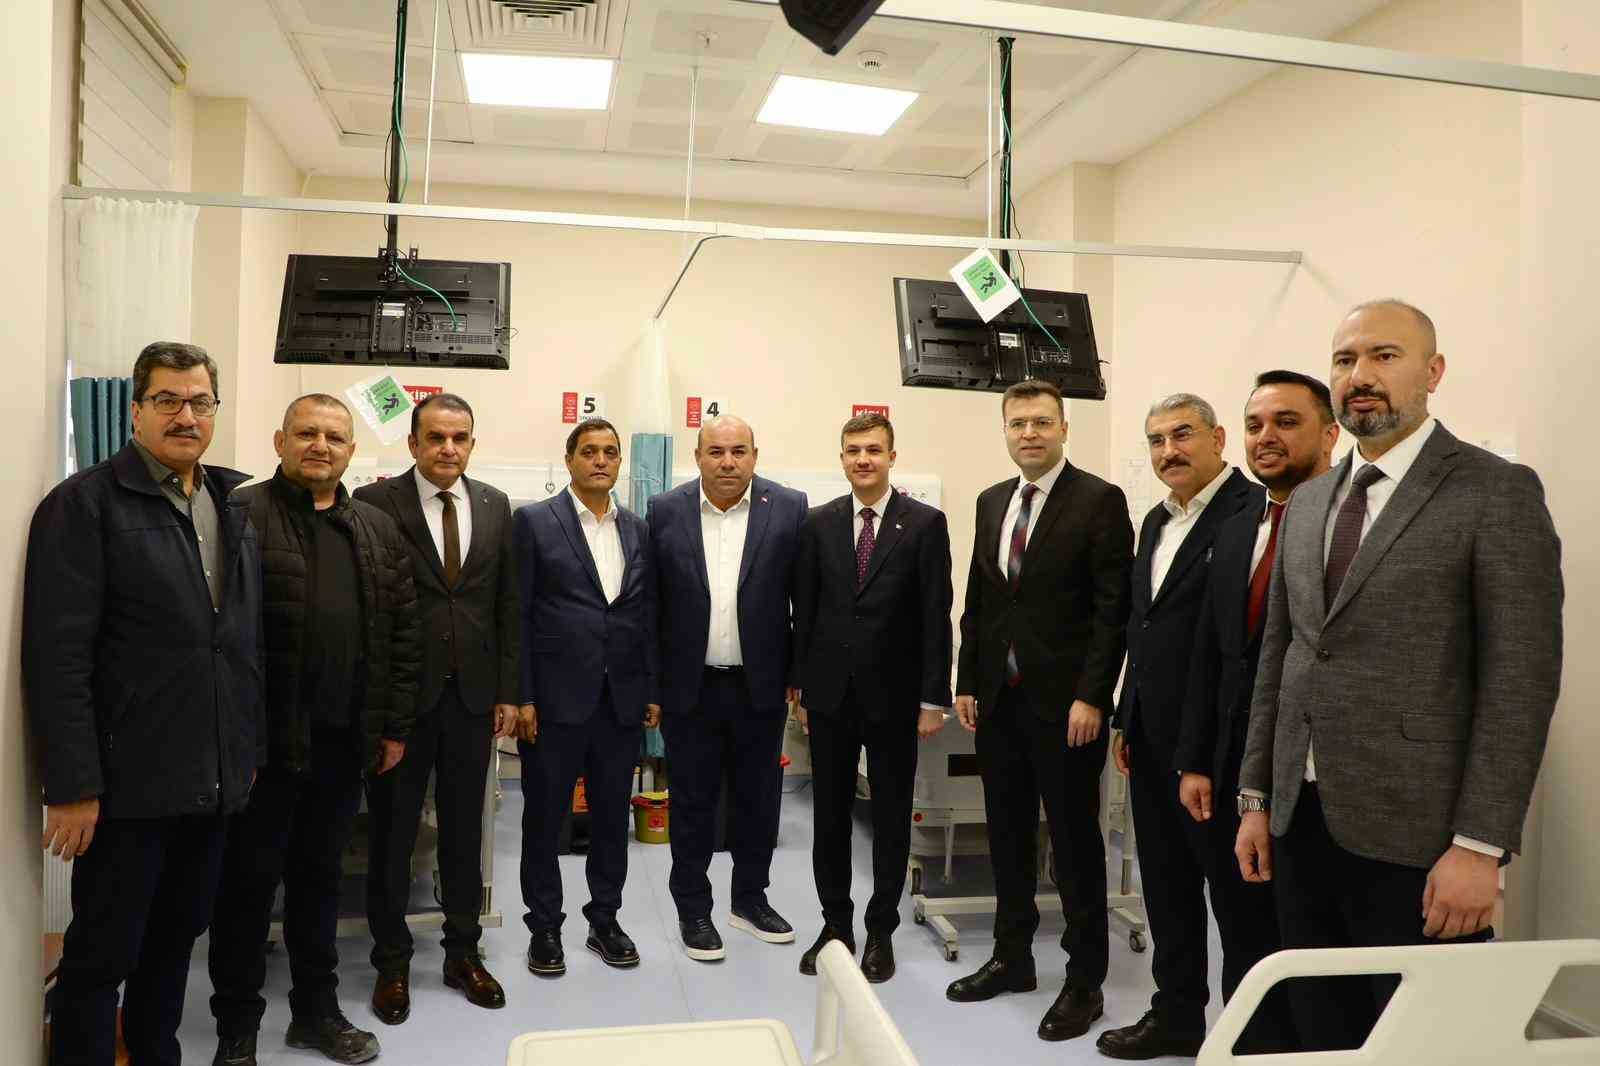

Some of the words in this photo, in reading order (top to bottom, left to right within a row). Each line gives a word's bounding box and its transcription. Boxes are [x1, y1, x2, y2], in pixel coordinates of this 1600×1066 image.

[408, 389, 440, 400] KİR
[583, 397, 596, 414] 5
[706, 402, 720, 417] 4
[855, 408, 886, 417] Kİİ
